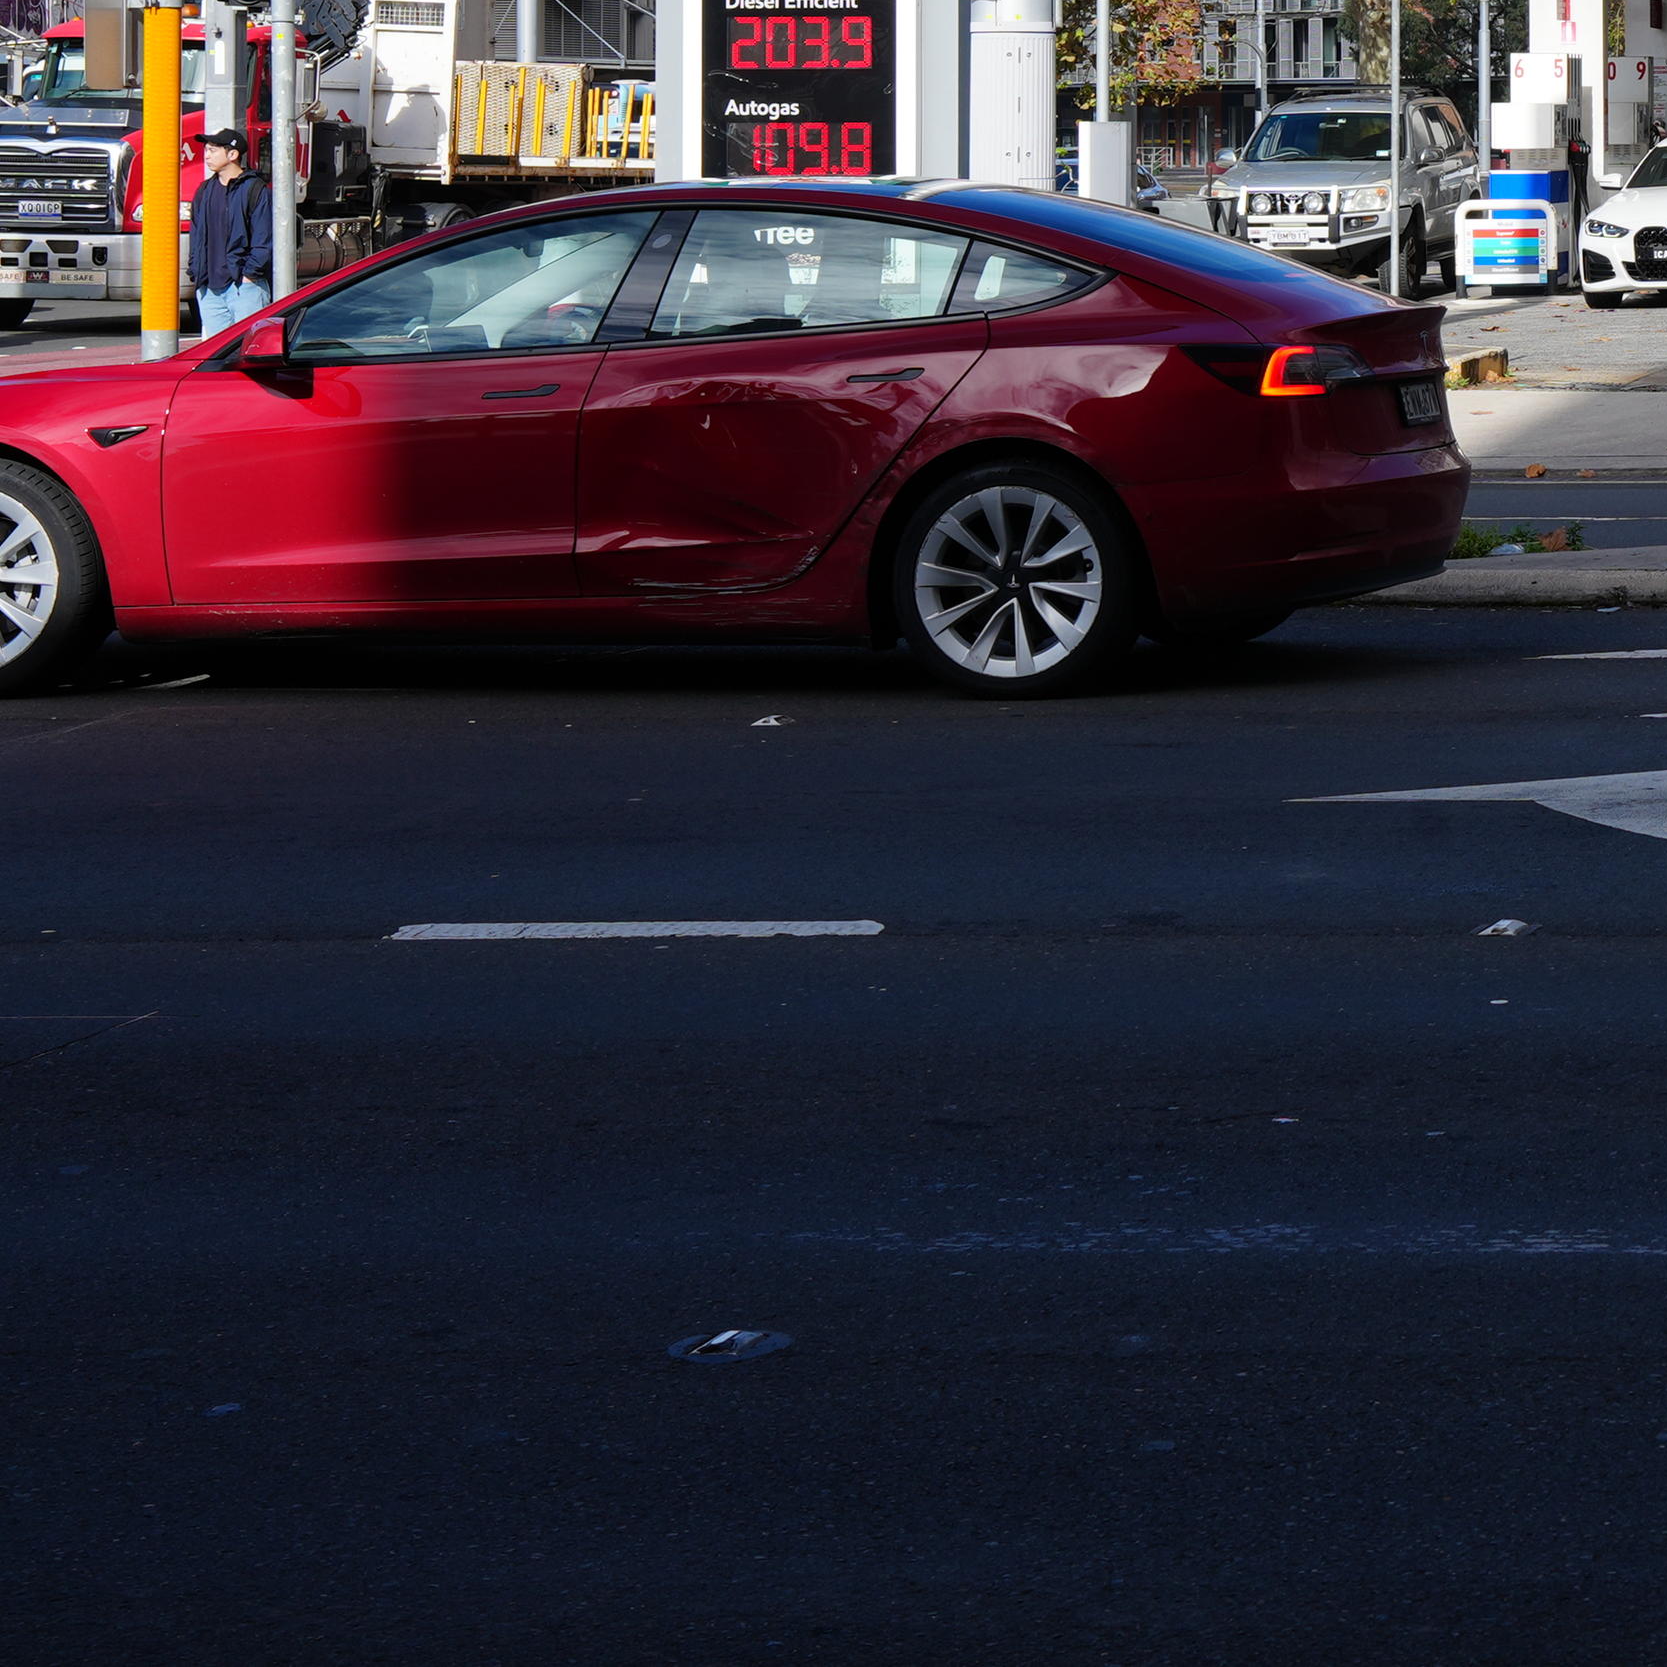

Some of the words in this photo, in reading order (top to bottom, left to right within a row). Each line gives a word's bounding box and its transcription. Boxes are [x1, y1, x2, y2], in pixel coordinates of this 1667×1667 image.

[730, 16, 873, 69] 203.9
[1514, 59, 1524, 78] 6
[1554, 59, 1563, 78] 5
[1636, 61, 1647, 80] 9
[725, 99, 800, 120] Autogas
[753, 122, 873, 175] 109.8
